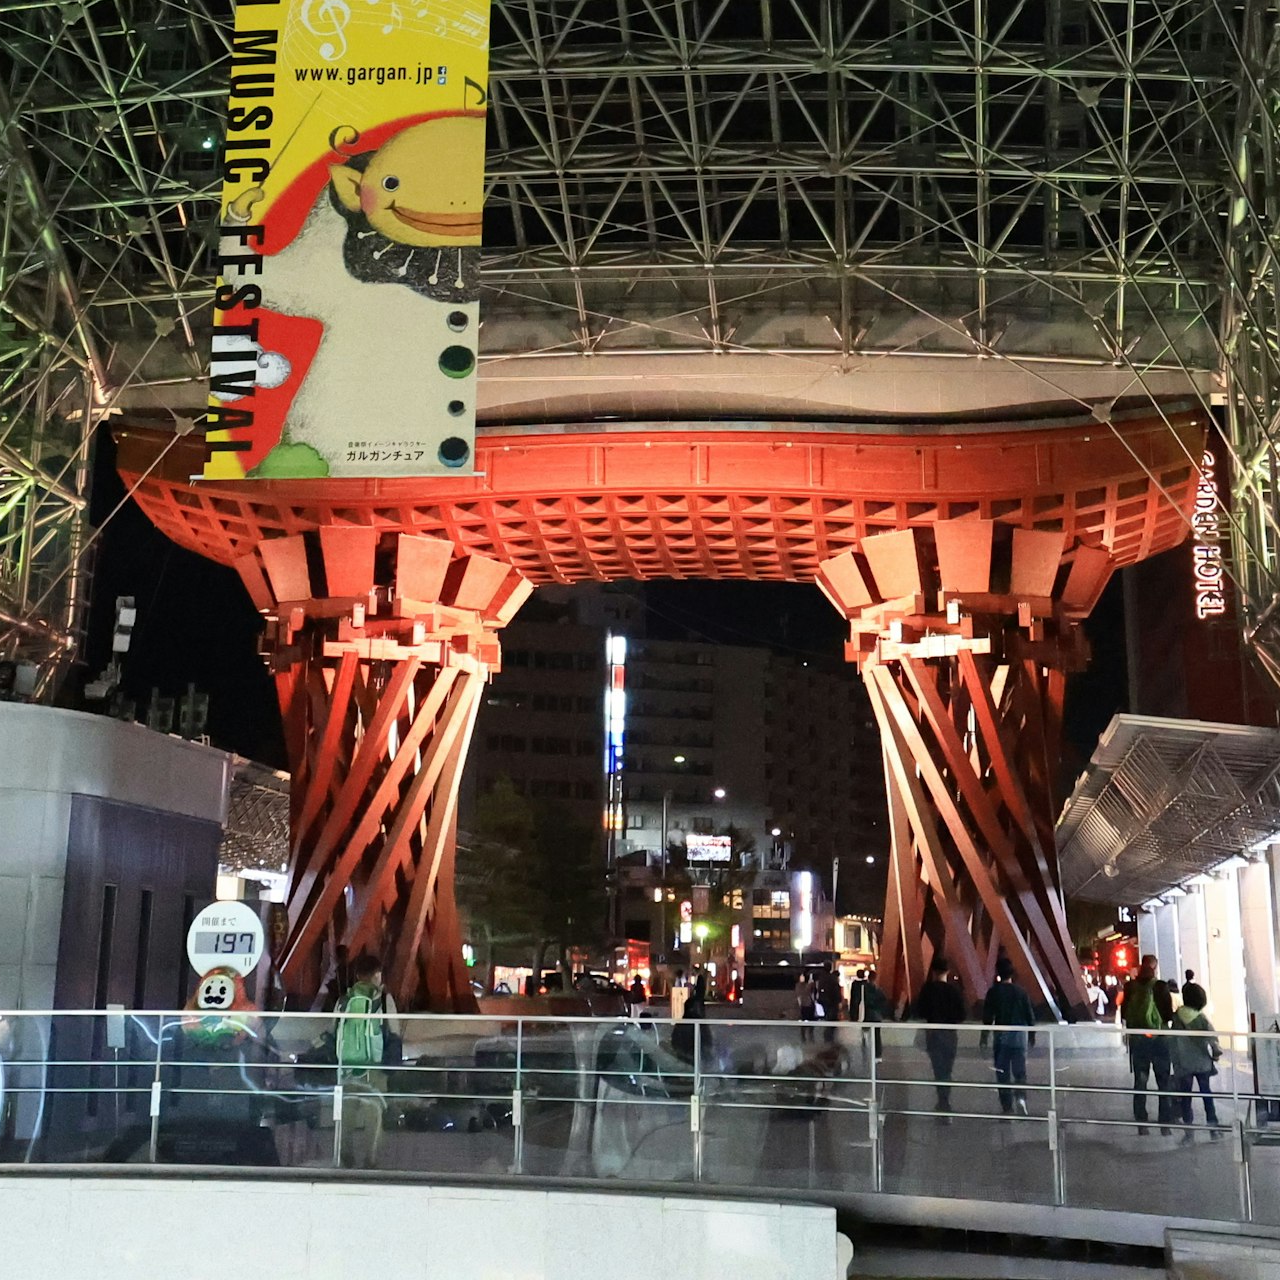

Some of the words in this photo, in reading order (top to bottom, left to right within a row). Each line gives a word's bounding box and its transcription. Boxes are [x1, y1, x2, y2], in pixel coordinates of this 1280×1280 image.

[295, 63, 433, 85] www.gargan.jp
[223, 30, 283, 184] MUSIC
[204, 224, 265, 464] FESTIVAL
[346, 450, 425, 462] ガルガンチュア
[1193, 545, 1226, 620] HOTEL
[201, 916, 237, 927] 開催まで
[214, 933, 254, 954] 197
